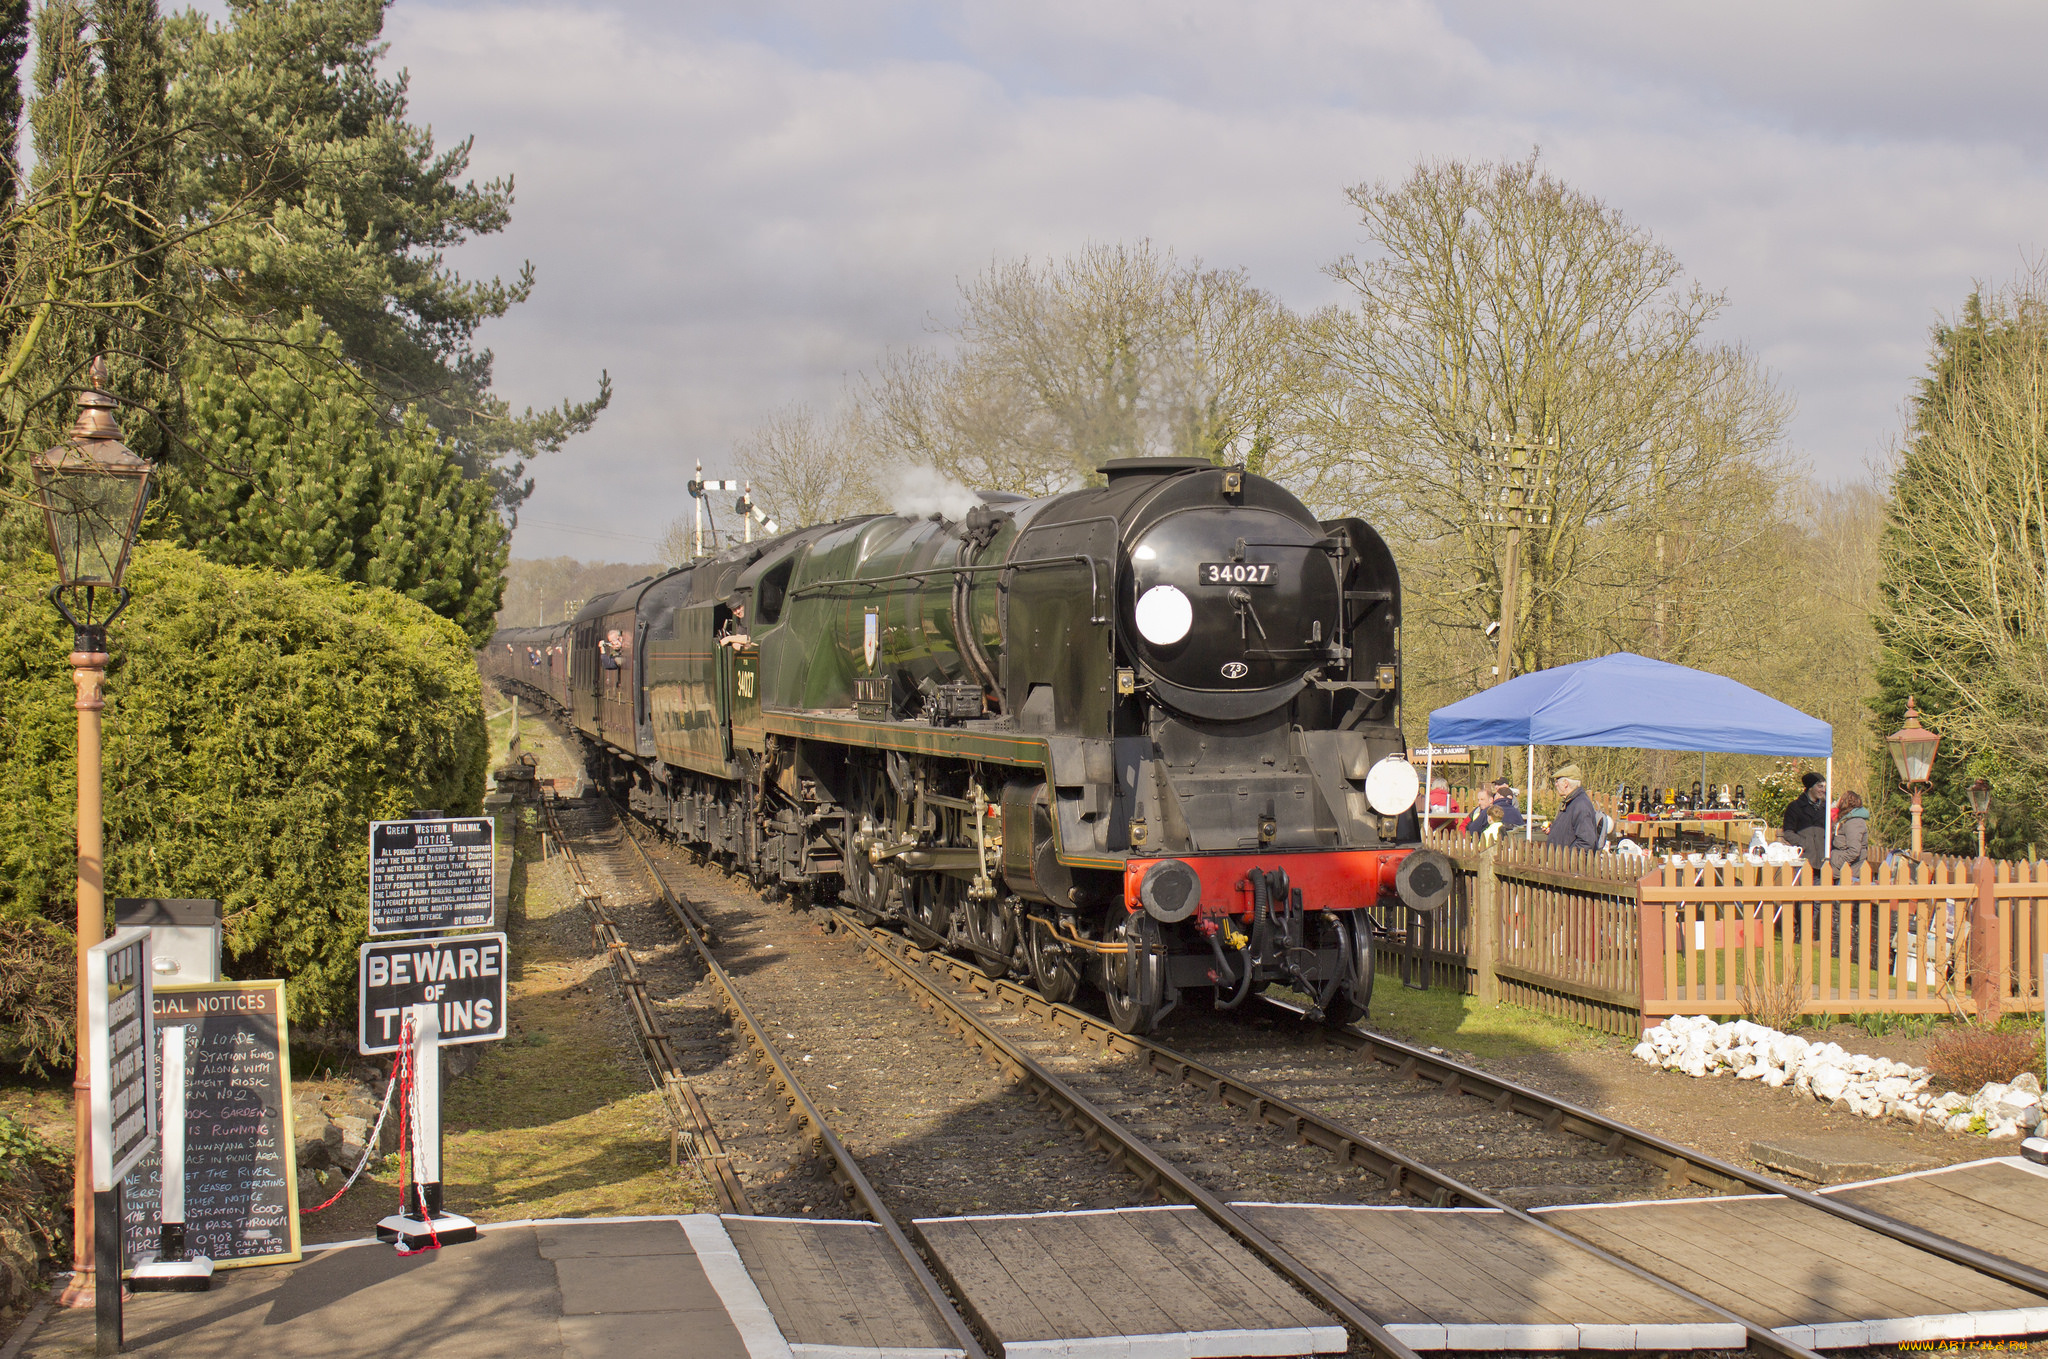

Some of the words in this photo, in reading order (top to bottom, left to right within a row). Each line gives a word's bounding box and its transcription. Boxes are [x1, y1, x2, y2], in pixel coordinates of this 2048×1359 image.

[1208, 565, 1270, 582] 34027
[1230, 664, 1241, 672] 73
[737, 670, 754, 698] 34027
[386, 826, 409, 835] GREAT
[414, 824, 447, 834] WESTERN
[417, 835, 452, 845] NOTICE.
[382, 848, 392, 856] ALL
[396, 872, 426, 880] PROVISIONS
[393, 882, 413, 890] PERSON
[428, 879, 457, 887] TRESPASSES
[386, 890, 400, 898] LINES
[409, 888, 430, 896] RAILWAY
[386, 898, 407, 906] PENALTY
[374, 916, 385, 924] FOR
[386, 915, 404, 924] EVERY
[454, 916, 462, 924] BY
[368, 945, 500, 988] BEWARE
[424, 984, 446, 1001] OF
[197, 994, 266, 1012] NOTICES
[200, 1050, 246, 1062] STATION
[250, 1048, 275, 1060] FUND
[202, 1065, 239, 1075] ALONG
[244, 1062, 270, 1074] WITH
[231, 1078, 270, 1088] KIOSK
[220, 1106, 267, 1119] GARDEN
[188, 1126, 200, 1136] IS
[212, 1124, 269, 1136] RUNNING
[248, 1137, 276, 1148] SALE
[211, 1156, 222, 1164] IN
[124, 1174, 142, 1186] WE
[206, 1168, 228, 1178] THE
[238, 1166, 276, 1178] RIVER
[198, 1184, 232, 1192] CEASED
[240, 1178, 286, 1190] OPERATING
[128, 1200, 160, 1211] UNTIL
[124, 1210, 146, 1224] THE
[251, 1204, 284, 1214] GOODS
[205, 1221, 232, 1230] PASS
[236, 1216, 288, 1228] THROUGH
[127, 1240, 161, 1254] HERE
[235, 1240, 258, 1248] GALA
